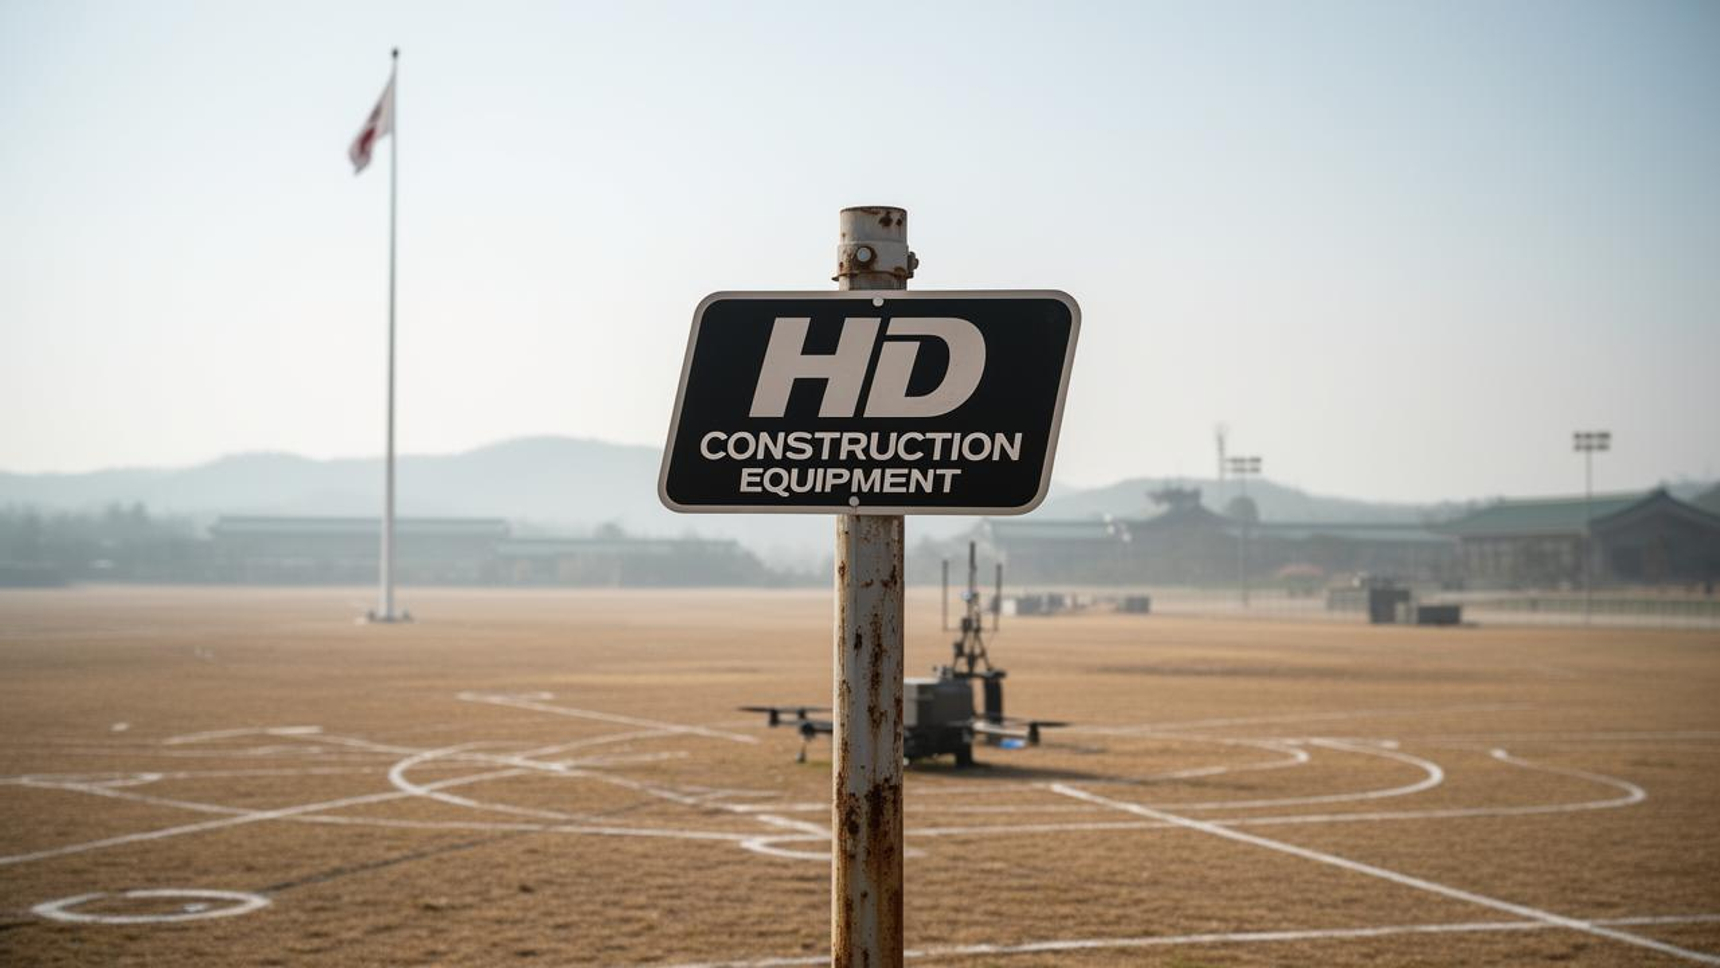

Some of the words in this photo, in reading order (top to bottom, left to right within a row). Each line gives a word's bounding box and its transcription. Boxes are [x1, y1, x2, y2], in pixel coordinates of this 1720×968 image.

[748, 317, 986, 418] HD
[700, 431, 1022, 461] CONSTRUCTION
[740, 467, 962, 497] EQUIPMENT
